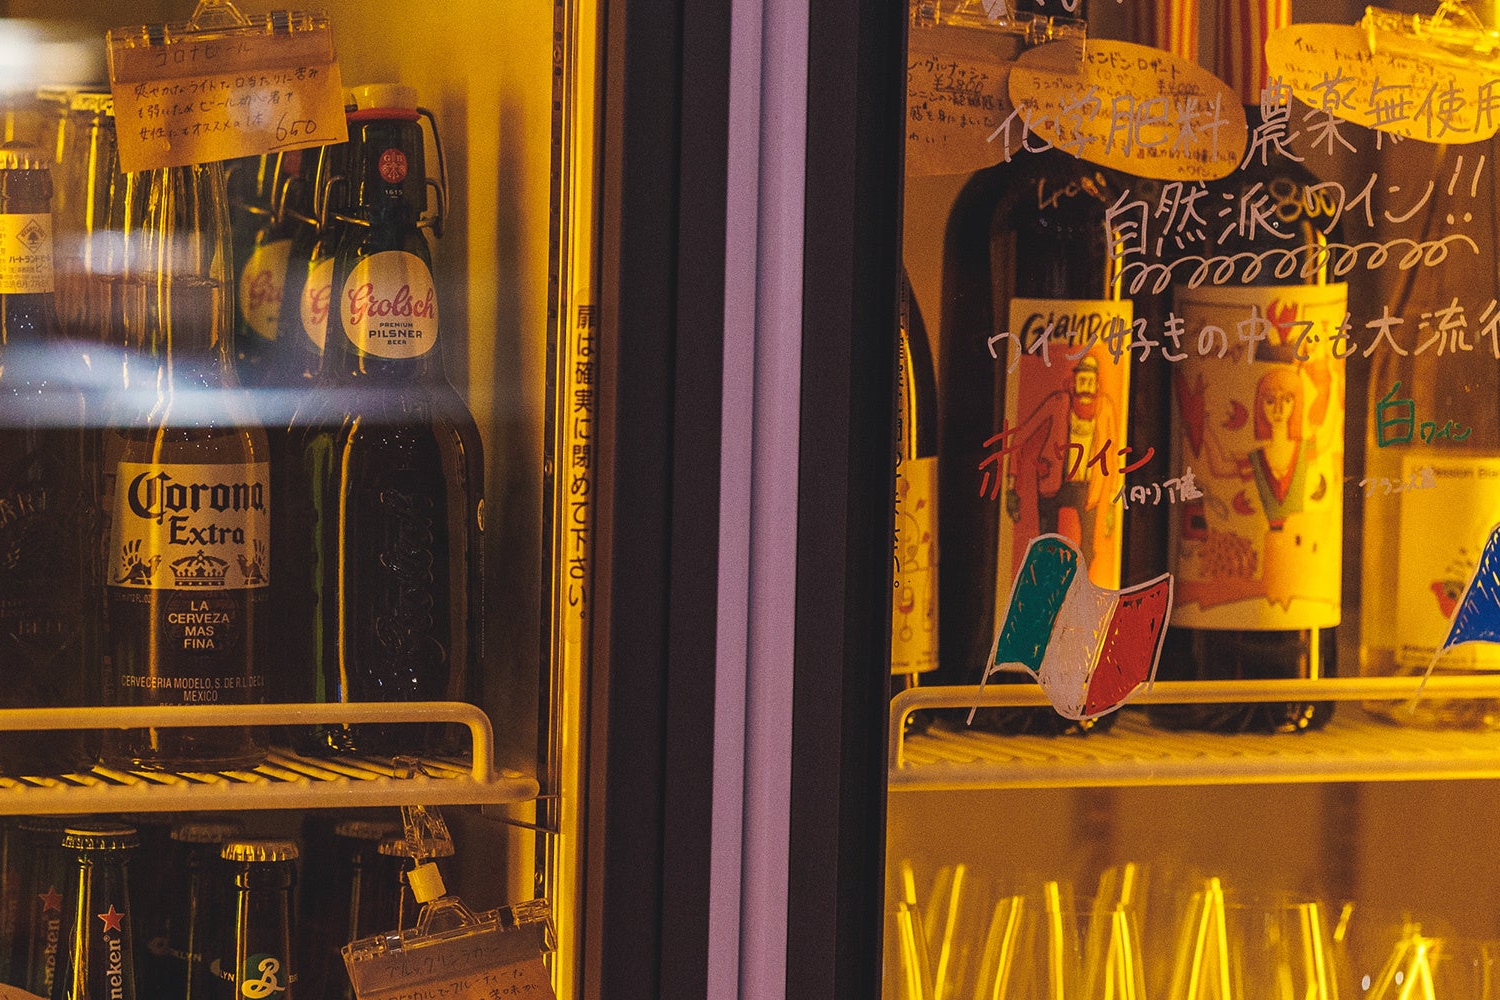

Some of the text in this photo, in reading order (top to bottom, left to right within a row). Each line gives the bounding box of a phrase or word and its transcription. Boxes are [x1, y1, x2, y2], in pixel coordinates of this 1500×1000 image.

[275, 110, 319, 142] 650
[348, 282, 435, 326] Grolsch
[368, 330, 423, 340] PILSNER
[387, 338, 407, 346] BEER
[1377, 381, 1472, 448] 白ワイン
[568, 304, 596, 619] 扉は確実に閉めて下さい。
[127, 471, 267, 525] Corona
[168, 515, 246, 546] Extra
[190, 601, 209, 612] LA
[168, 613, 230, 624] CERVEZA
[185, 626, 215, 637] MAS
[183, 638, 215, 649] FINA
[121, 675, 173, 689] CERVECERIA
[183, 690, 219, 702] MEXICO
